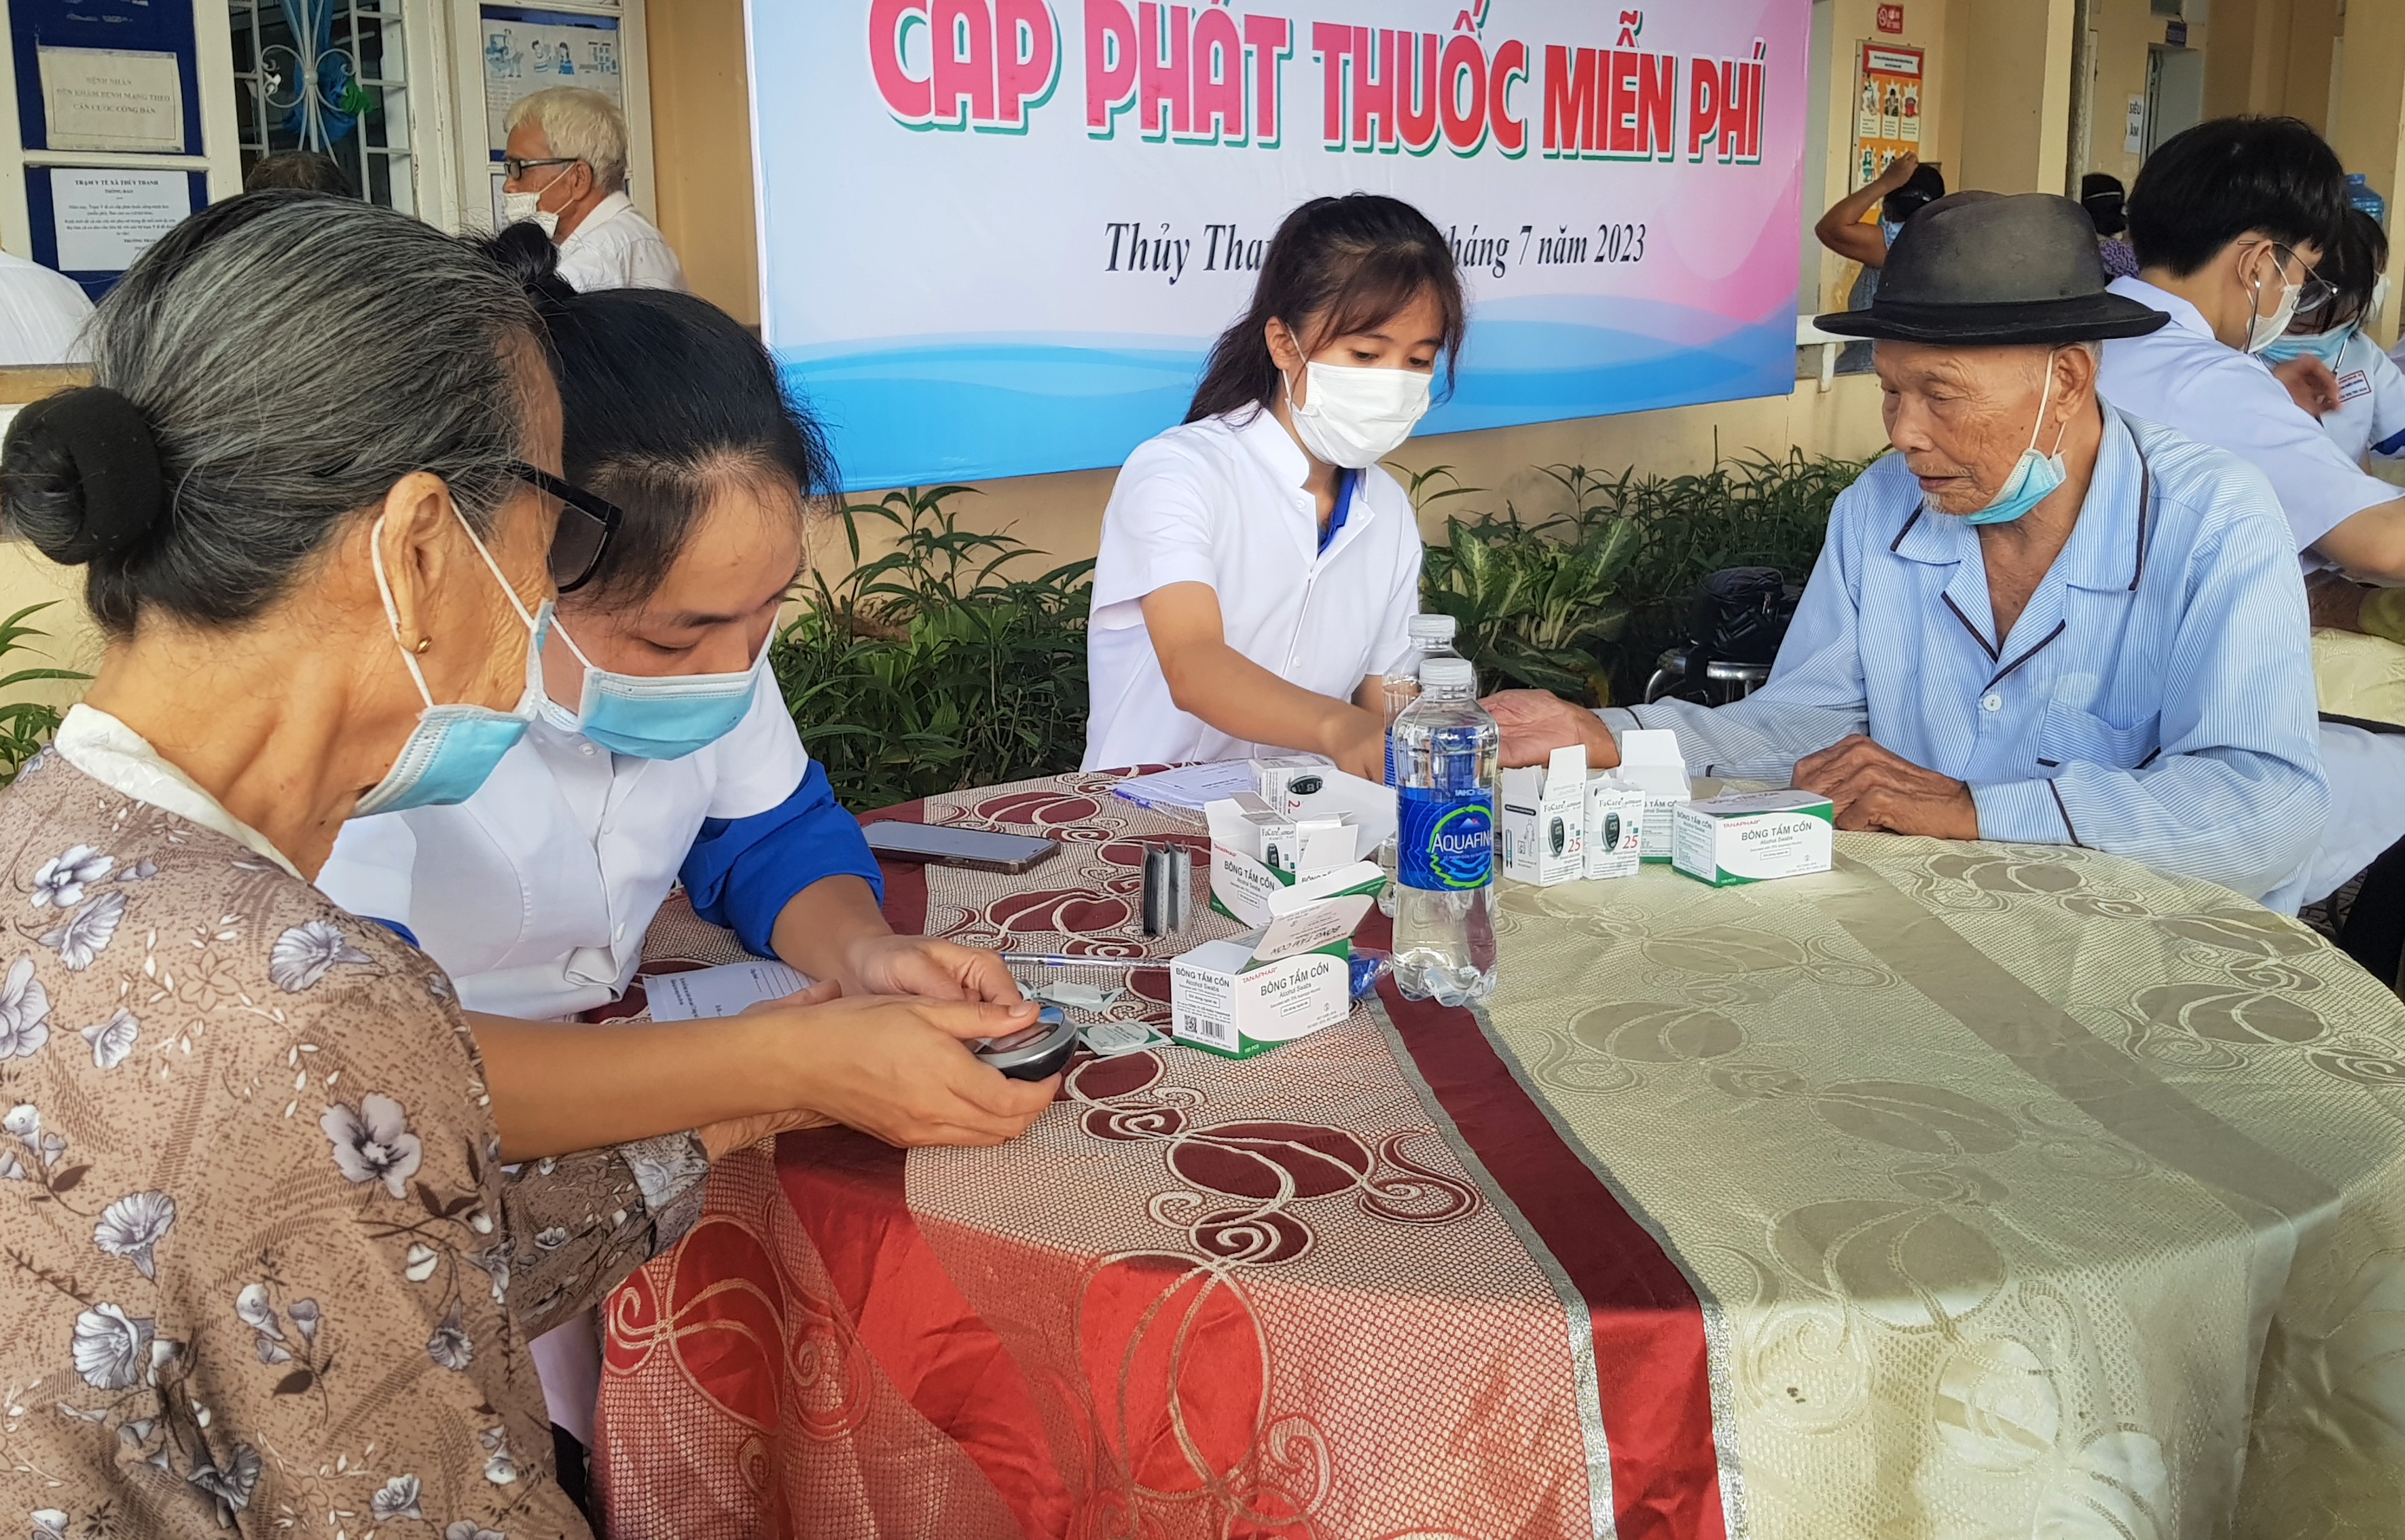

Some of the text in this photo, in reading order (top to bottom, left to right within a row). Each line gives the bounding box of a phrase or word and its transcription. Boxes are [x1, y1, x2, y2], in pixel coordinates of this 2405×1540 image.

[1312, 0, 1529, 160] THUỐC
[1542, 10, 1678, 164] MIỄN
[1688, 37, 1766, 165] PHÍ
[1104, 222, 1190, 286] Thủy
[1519, 225, 1532, 265] 7
[1537, 225, 1588, 265] năm
[1594, 223, 1646, 263] 2023
[1430, 829, 1492, 854] AQUAFIN
[1622, 835, 1639, 849] 25
[1741, 829, 1769, 841] BÔNG
[1568, 837, 1581, 853] 25
[1225, 860, 1243, 876] BÔNG
[1176, 967, 1195, 979] BÔNG
[1261, 978, 1287, 996] BÔNG
